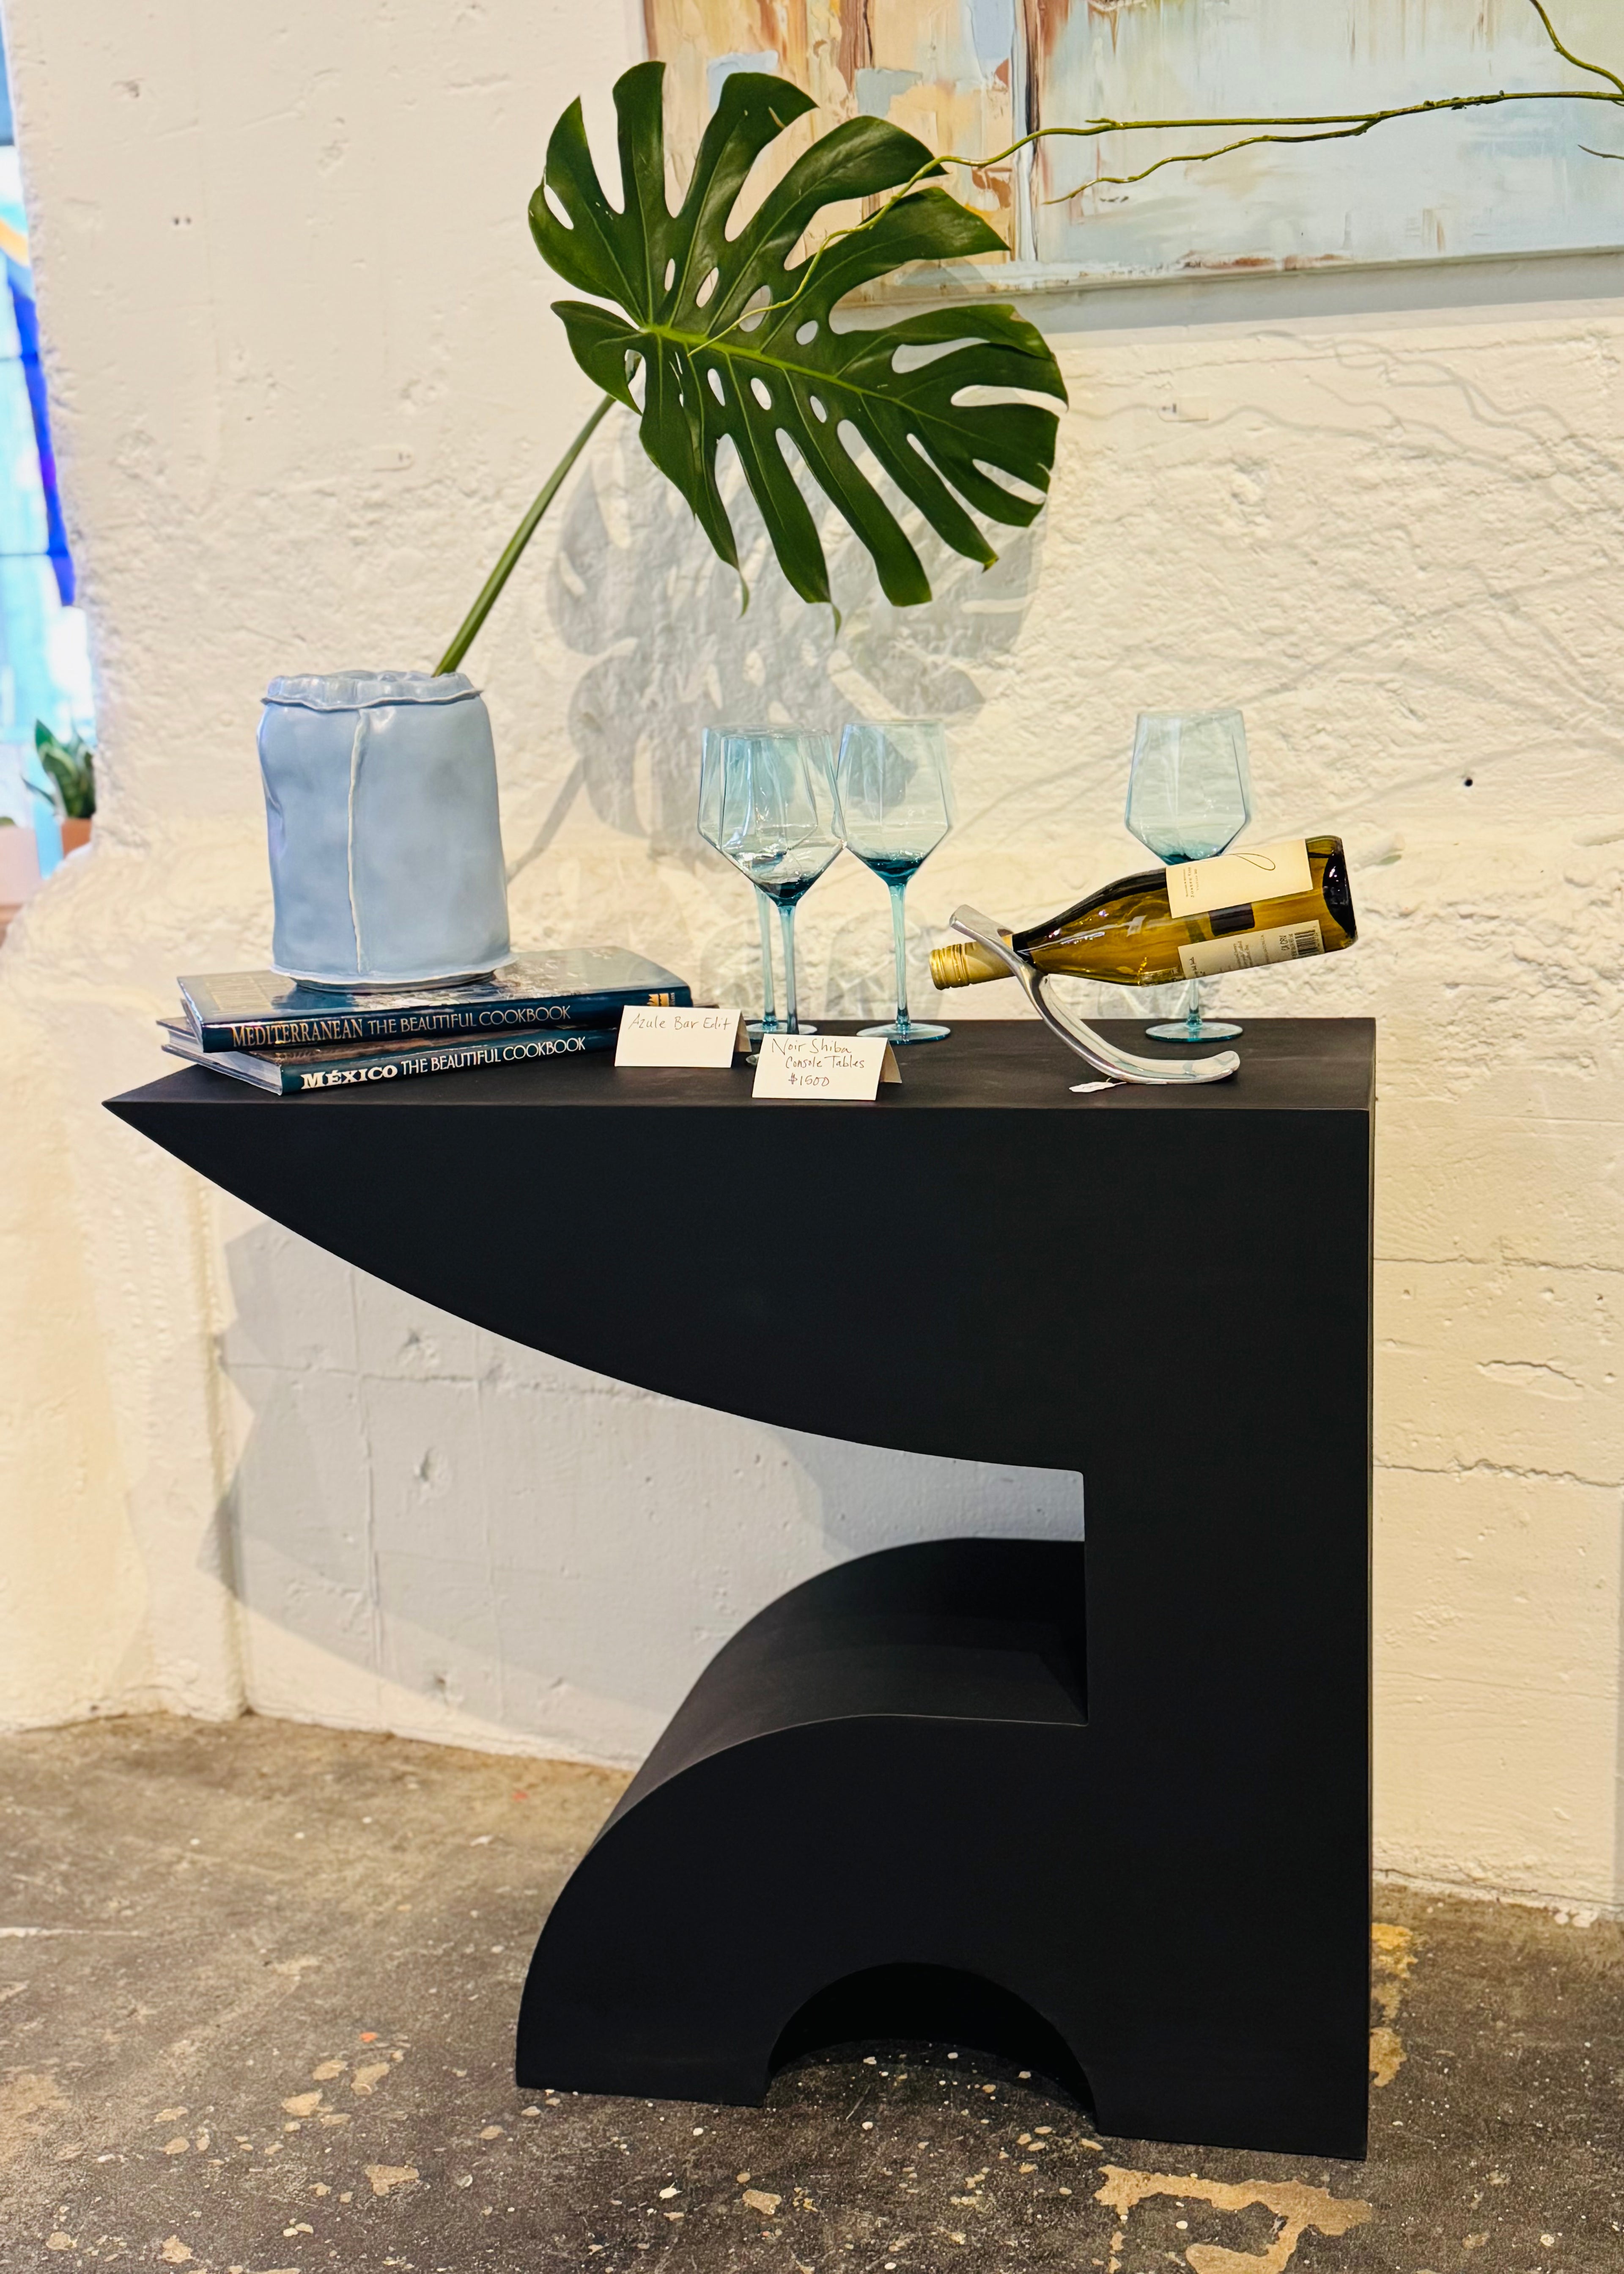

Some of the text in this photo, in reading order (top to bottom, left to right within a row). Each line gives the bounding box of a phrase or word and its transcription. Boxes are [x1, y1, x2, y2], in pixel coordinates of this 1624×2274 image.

[232, 1005, 571, 1048] MEDITERRANEAN THE BEAUTIFUL COOKBOOK
[674, 1016, 700, 1030] Bar
[703, 1016, 732, 1030] Edit
[772, 1038, 852, 1055] Noir Shiba
[300, 1036, 586, 1090] MÉXICO THE BEAUTIFUL COOKBOOK
[785, 1055, 865, 1068] Console Tables
[788, 1072, 830, 1087] $1500
